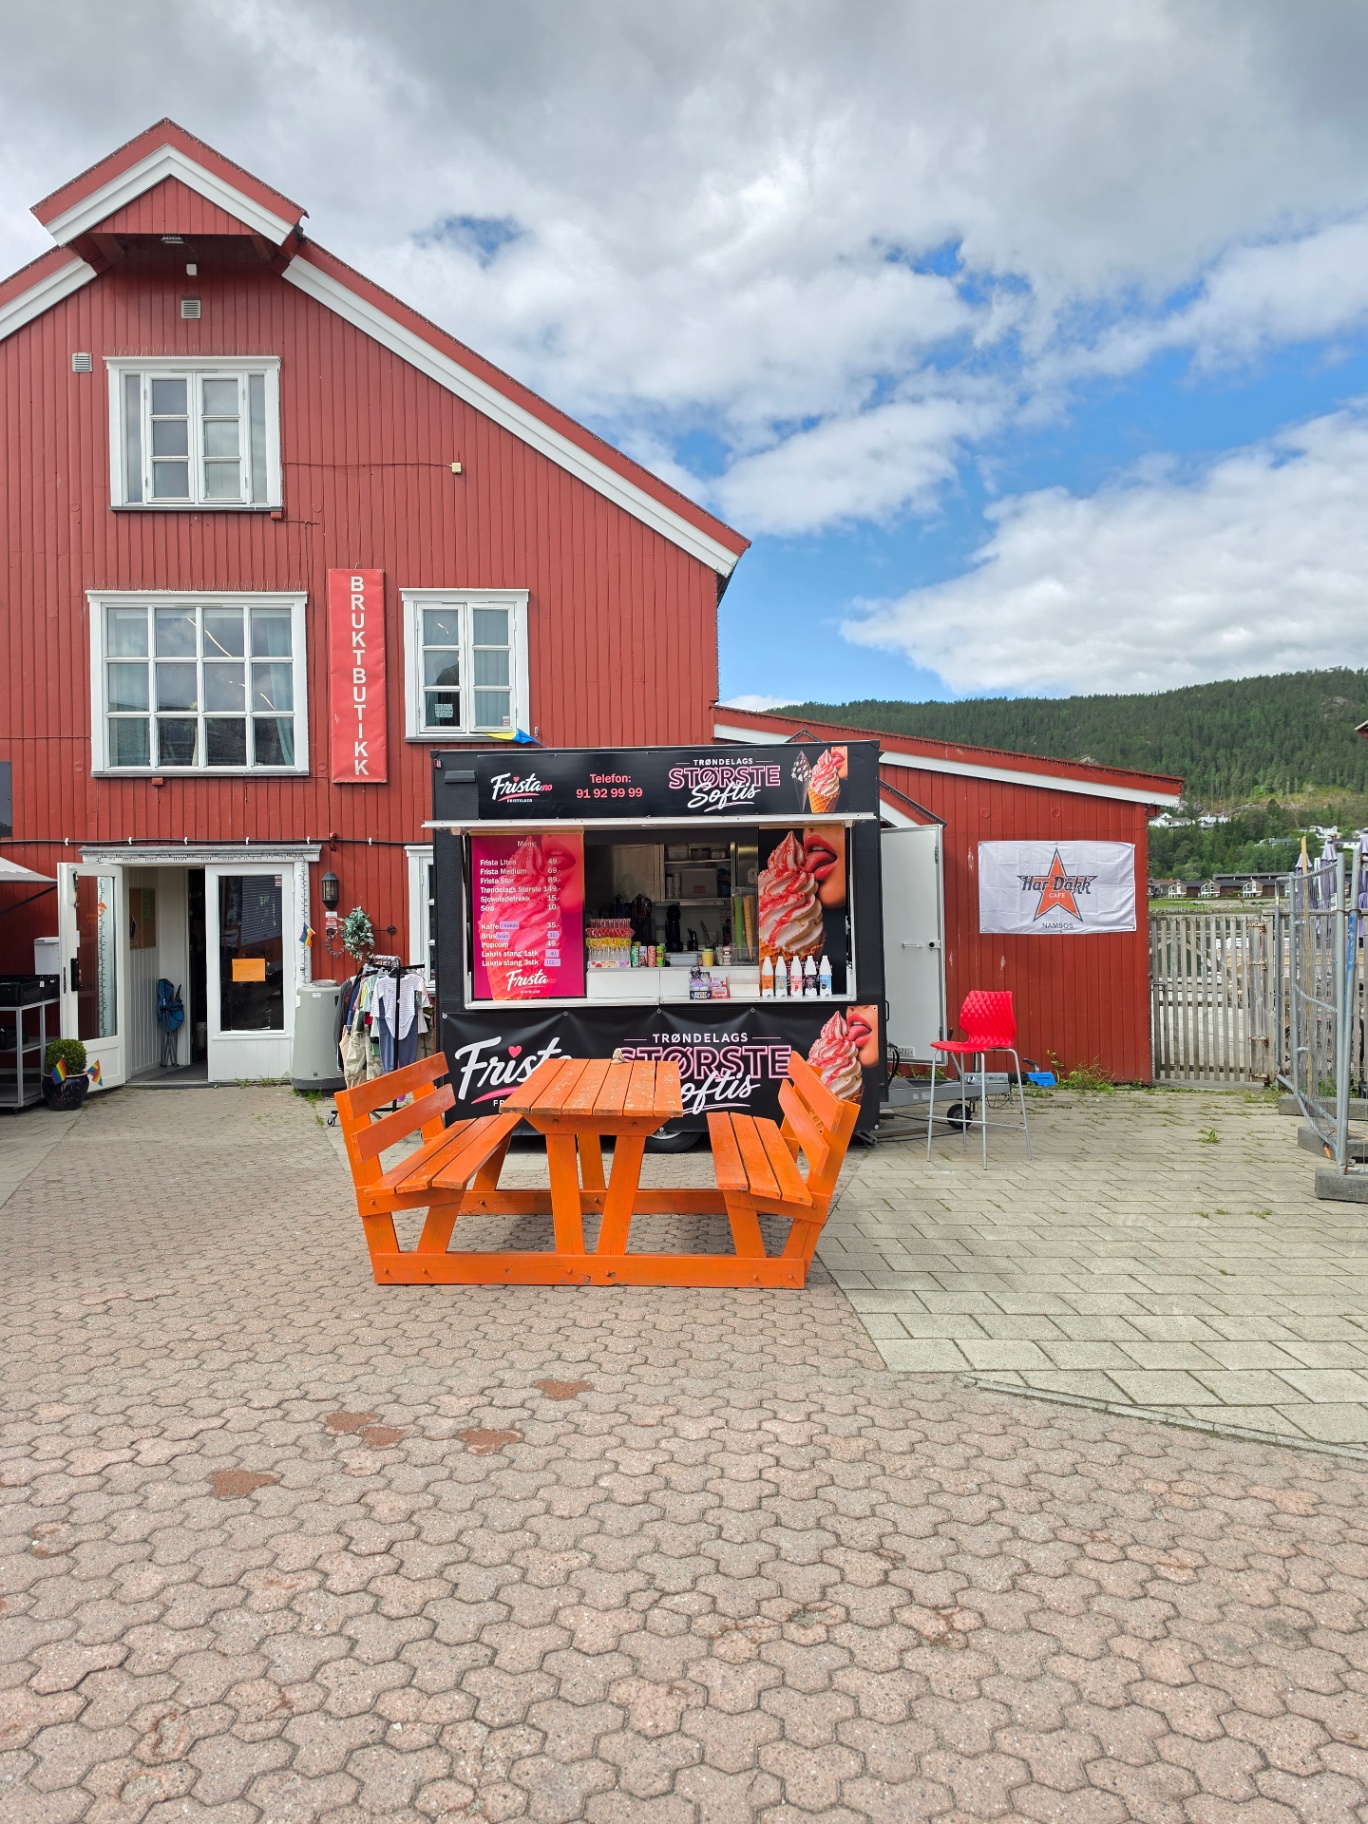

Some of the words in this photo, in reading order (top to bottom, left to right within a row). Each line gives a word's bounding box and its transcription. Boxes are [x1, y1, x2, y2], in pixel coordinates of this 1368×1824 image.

[351, 576, 369, 776] BRUKTBUTIKK
[693, 758, 753, 766] TRØNDELAGS
[589, 773, 632, 784] Telefon:
[668, 765, 781, 790] STØRSTE
[576, 788, 591, 799] 91
[593, 788, 608, 799] 92
[610, 787, 625, 798] 99
[628, 787, 643, 798] 99
[687, 781, 761, 810] Softis
[480, 886, 517, 894] Trøndelags
[1022, 875, 1049, 891] Har
[1053, 875, 1092, 894] Dåkk
[503, 950, 523, 959] stang
[503, 960, 523, 968] stang
[652, 1032, 748, 1043] TRØNDELAGS
[454, 1036, 572, 1100] Frist
[680, 1071, 761, 1115] oftis
